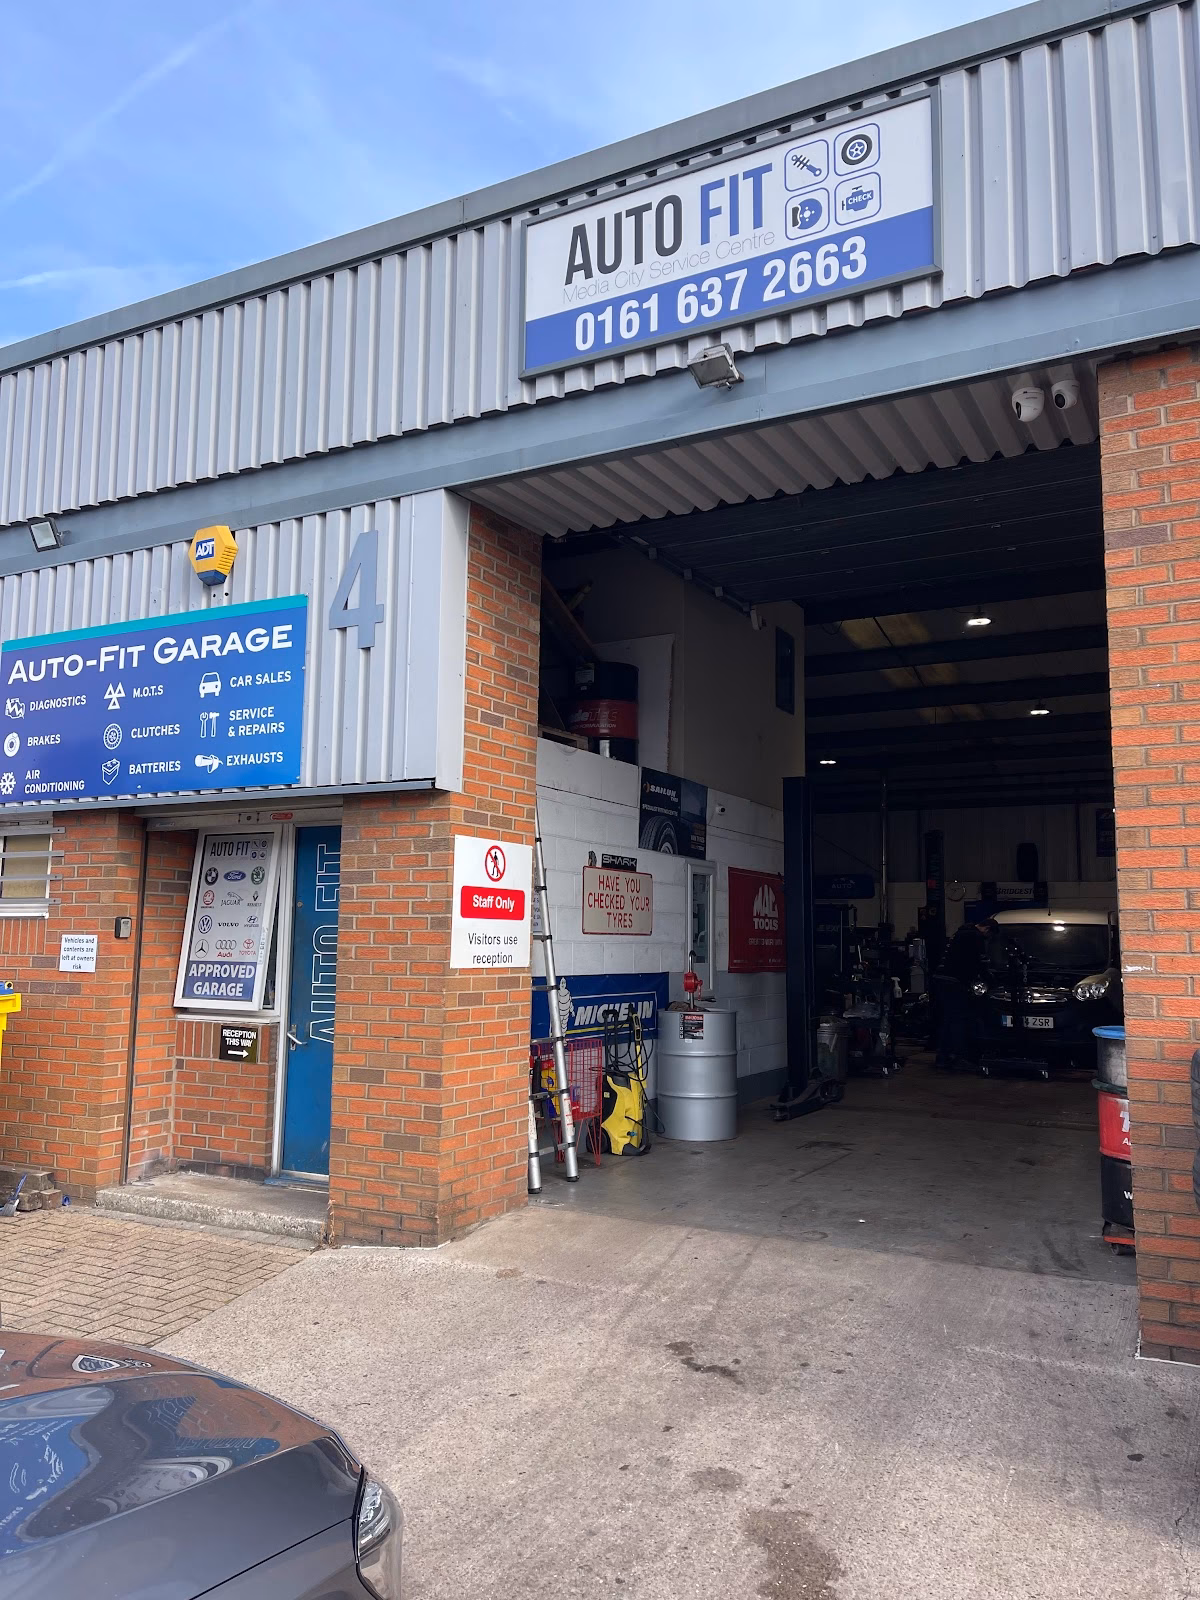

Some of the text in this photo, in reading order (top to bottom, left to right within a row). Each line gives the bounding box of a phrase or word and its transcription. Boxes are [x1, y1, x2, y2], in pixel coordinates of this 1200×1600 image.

[848, 191, 873, 206] CHECK
[564, 162, 773, 286] AUTO FIT
[563, 229, 775, 304] Media City Service Centre
[575, 235, 868, 351] 0161 637 2663
[195, 541, 215, 557] ADT
[329, 530, 384, 649] 4
[8, 624, 293, 685] AUTO-FIT GARAGE
[230, 671, 292, 688] CAR SALES
[133, 685, 164, 698] M.O.T.S
[30, 695, 87, 711] DIAGNOSTICS
[229, 706, 275, 721] SERVICE
[131, 724, 181, 738] CLUTCHES
[228, 722, 285, 737] & REPAIRS
[27, 734, 61, 746] BRAKES
[226, 751, 284, 766] EXHAUSTS
[25, 770, 41, 780] AIR
[129, 760, 181, 775] BATTERIES
[24, 780, 85, 794] CONDITIONING
[209, 840, 250, 857] AUTO FIT
[602, 855, 637, 867] SHARK
[227, 871, 242, 880] Ford
[598, 875, 641, 893] HAVE YOU
[472, 894, 515, 912] Staff Only
[587, 892, 650, 912] CHECKED YOUR
[607, 912, 633, 928] TYRES
[753, 918, 779, 931] TOOLS
[467, 932, 518, 945] Visitors use
[472, 951, 513, 966] reception
[189, 963, 255, 979] APPROVED
[193, 981, 244, 997] GARAGE
[574, 1001, 653, 1026] MICHEIN
[222, 1029, 257, 1039] RECEPTION
[225, 1037, 253, 1048] THIS WAY
